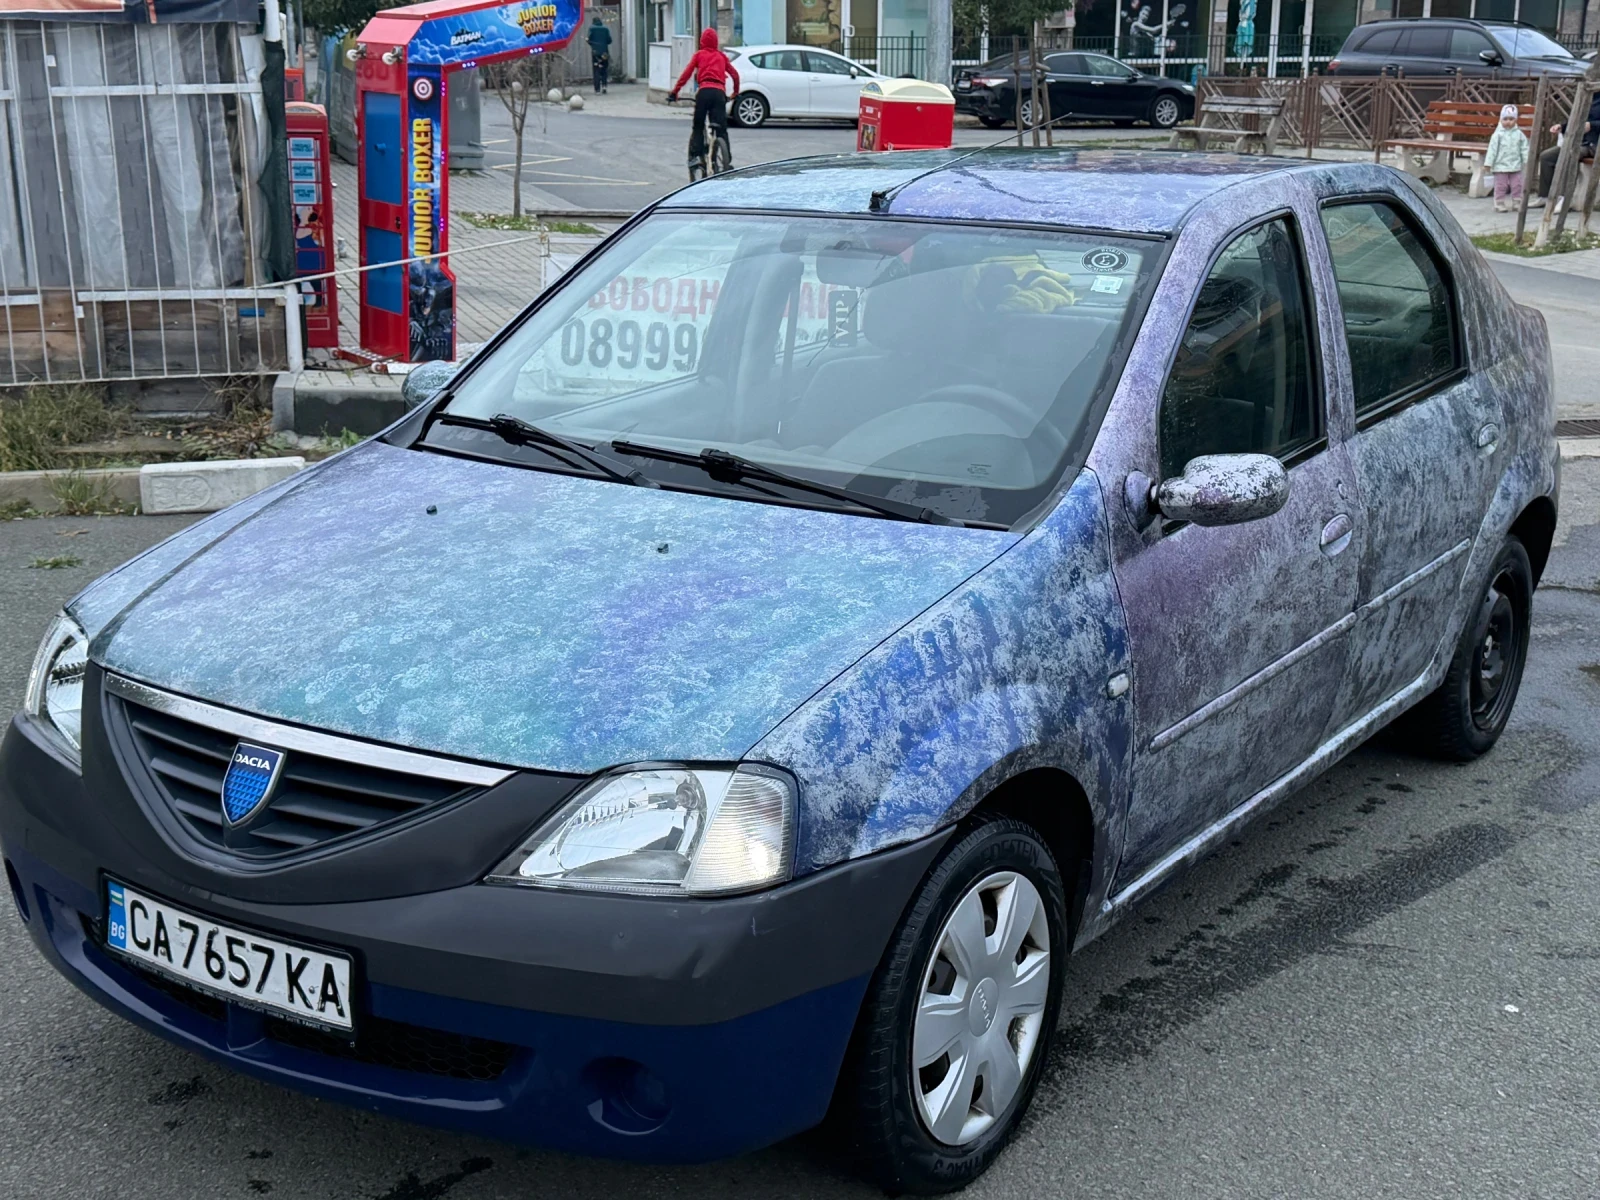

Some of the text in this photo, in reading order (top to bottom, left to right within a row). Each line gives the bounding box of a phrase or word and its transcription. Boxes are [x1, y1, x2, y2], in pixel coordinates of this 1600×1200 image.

[517, 4, 557, 25] JUNIOR
[523, 19, 554, 36] BOXER
[450, 31, 482, 46] BATMAN
[413, 118, 433, 264] JUNIOR BOXER
[587, 275, 721, 322] ВОБОДН
[834, 299, 849, 340] VIP
[560, 317, 705, 372] 08999
[234, 753, 271, 771] DACIA
[111, 921, 125, 940] BG
